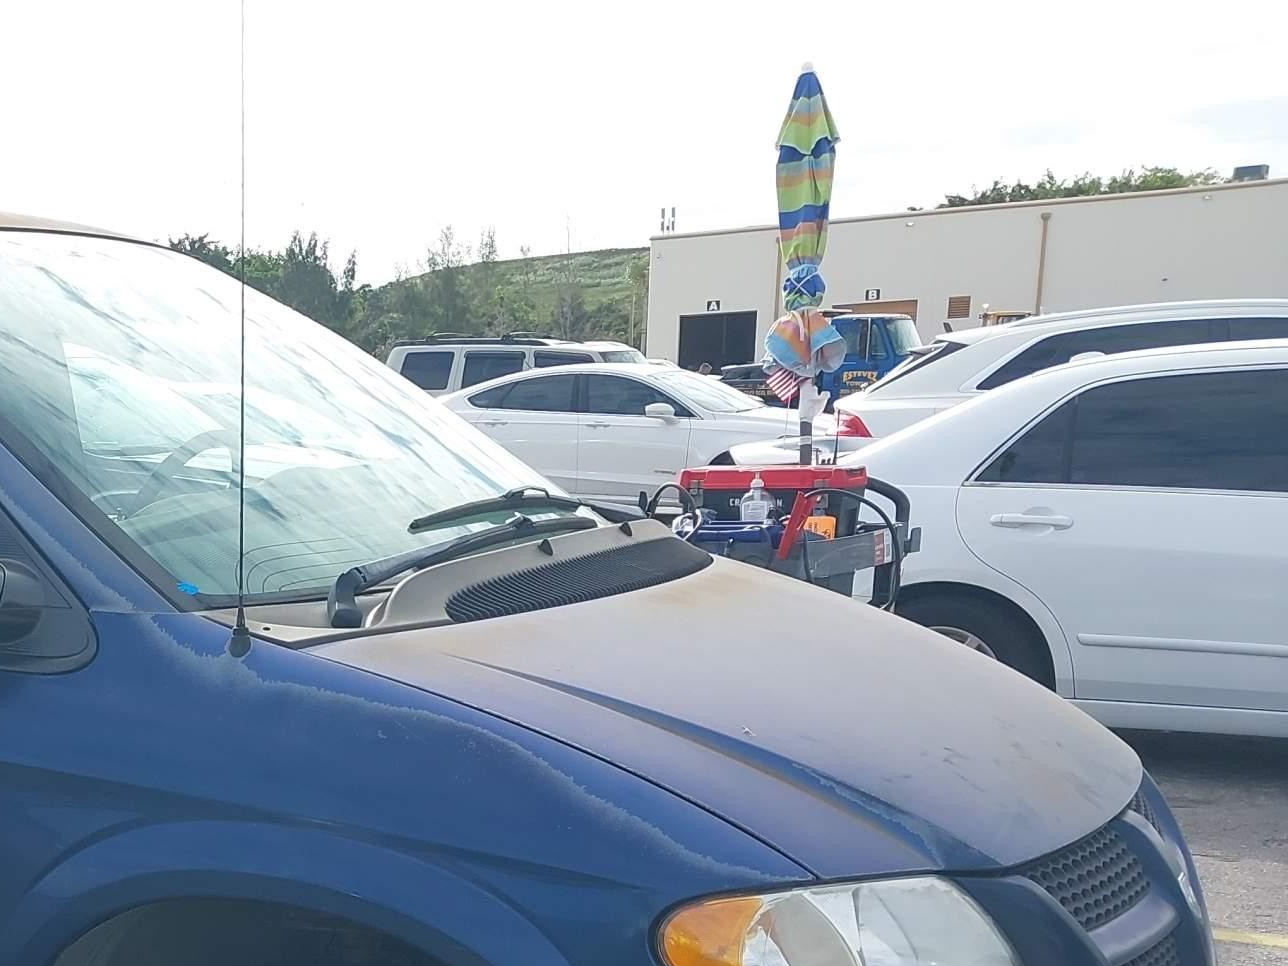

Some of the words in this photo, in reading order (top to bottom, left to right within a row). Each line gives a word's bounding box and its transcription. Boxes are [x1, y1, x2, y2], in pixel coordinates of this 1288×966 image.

[868, 289, 878, 300] B
[708, 300, 719, 311] A
[842, 370, 879, 383] ESTEVEZ
